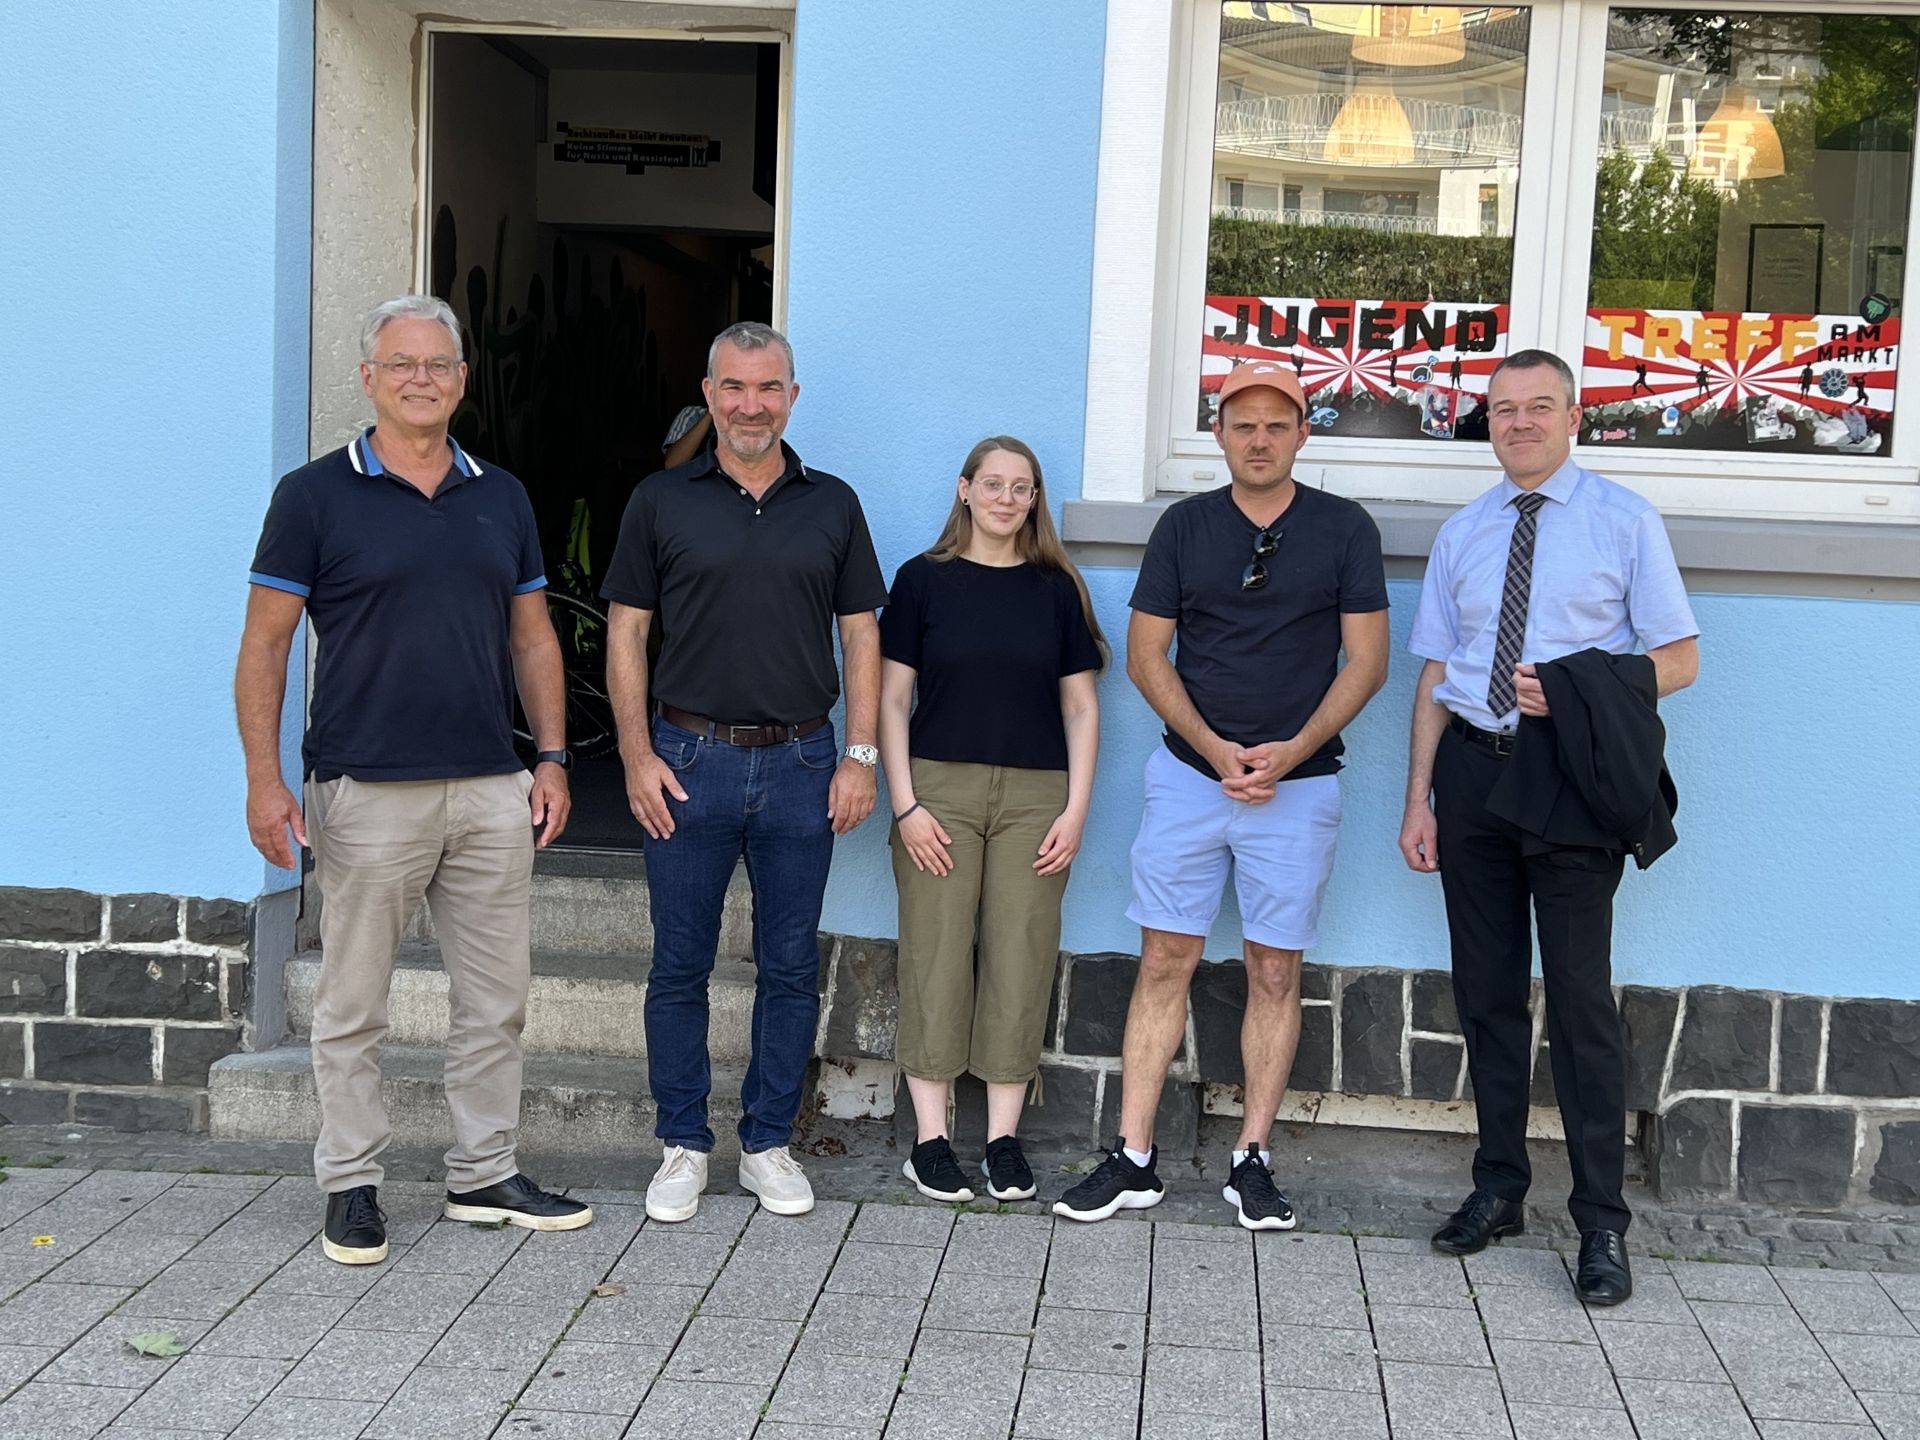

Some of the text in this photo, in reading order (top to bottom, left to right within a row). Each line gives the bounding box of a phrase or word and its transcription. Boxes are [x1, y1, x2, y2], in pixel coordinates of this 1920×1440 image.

[567, 143, 633, 152] Keine Stimme
[567, 150, 581, 159] für
[583, 152, 610, 160] Nazis
[612, 153, 630, 161] und
[1213, 304, 1498, 352] JUGEND
[1830, 323, 1881, 343] AM
[1600, 315, 1819, 362] TREFF
[1817, 346, 1894, 366] MARKT
